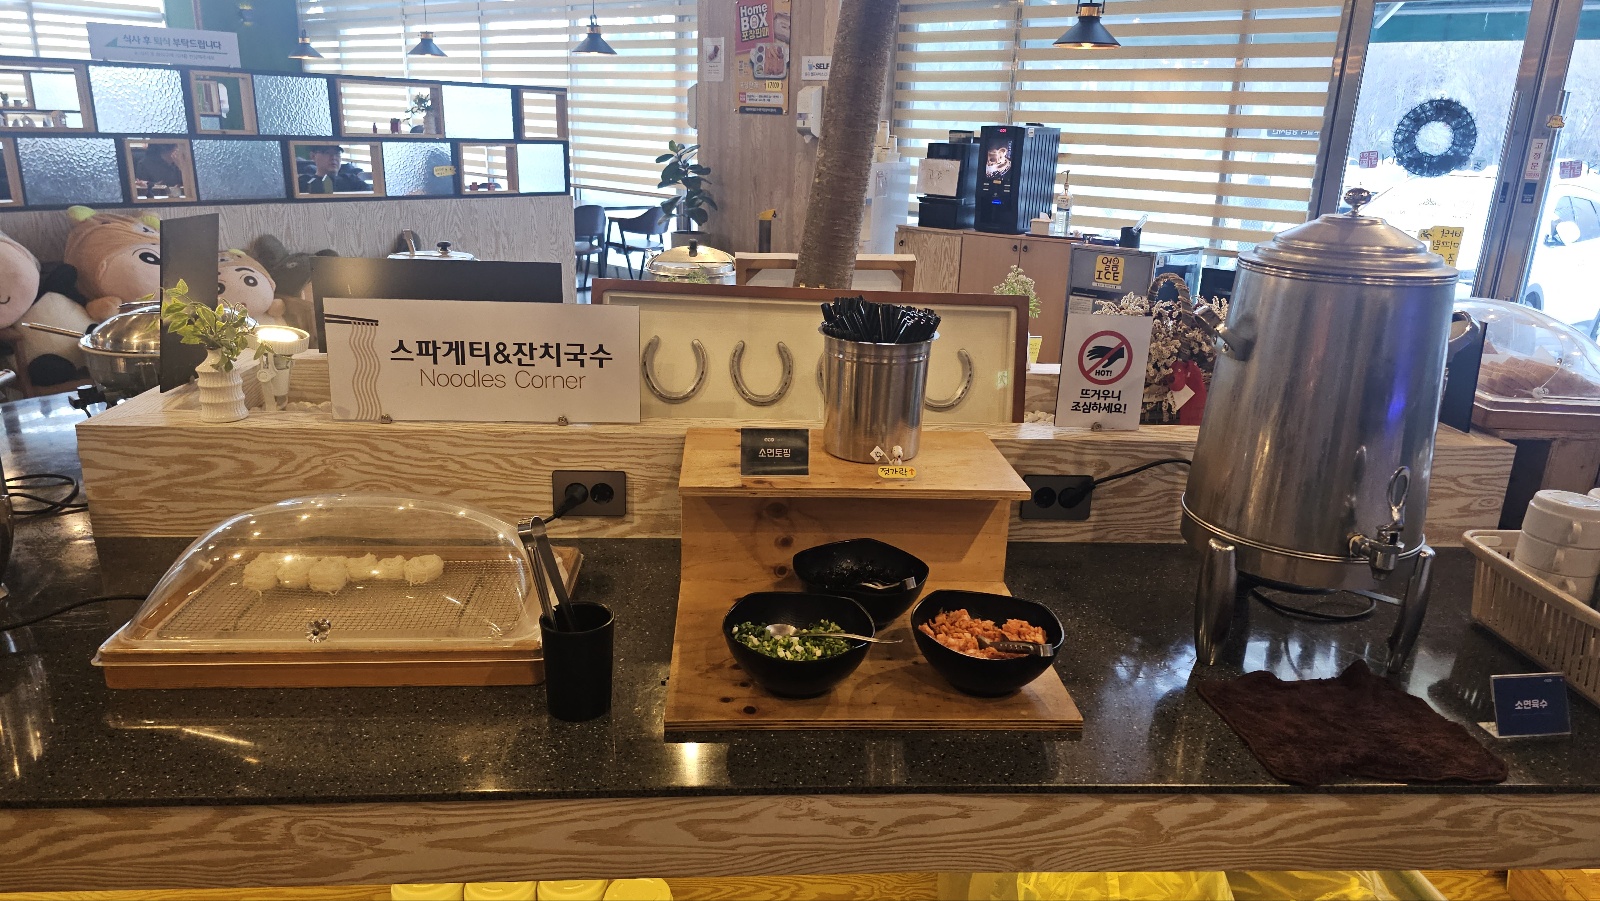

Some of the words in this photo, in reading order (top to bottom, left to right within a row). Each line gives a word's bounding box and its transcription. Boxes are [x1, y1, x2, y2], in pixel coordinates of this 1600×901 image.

[740, 3, 768, 17] Home
[740, 12, 769, 31] BOX
[123, 34, 141, 45] 식사
[143, 35, 152, 44] 후
[153, 36, 172, 47] 퇴식
[172, 37, 222, 50] 부탁드립니다
[1530, 142, 1544, 171] 고정문
[1102, 256, 1120, 272] 얼음
[1096, 270, 1120, 281] ICE
[390, 339, 613, 369] 스파게티&잔치국수
[420, 368, 507, 388] Noodles
[514, 370, 587, 389] Corner
[1095, 369, 1113, 377] HOT!
[1080, 388, 1122, 401] 뜨거우니
[1070, 401, 1128, 414] 조심하세요!
[758, 448, 791, 458] 소면토핑
[1514, 698, 1548, 710] 소면육수
